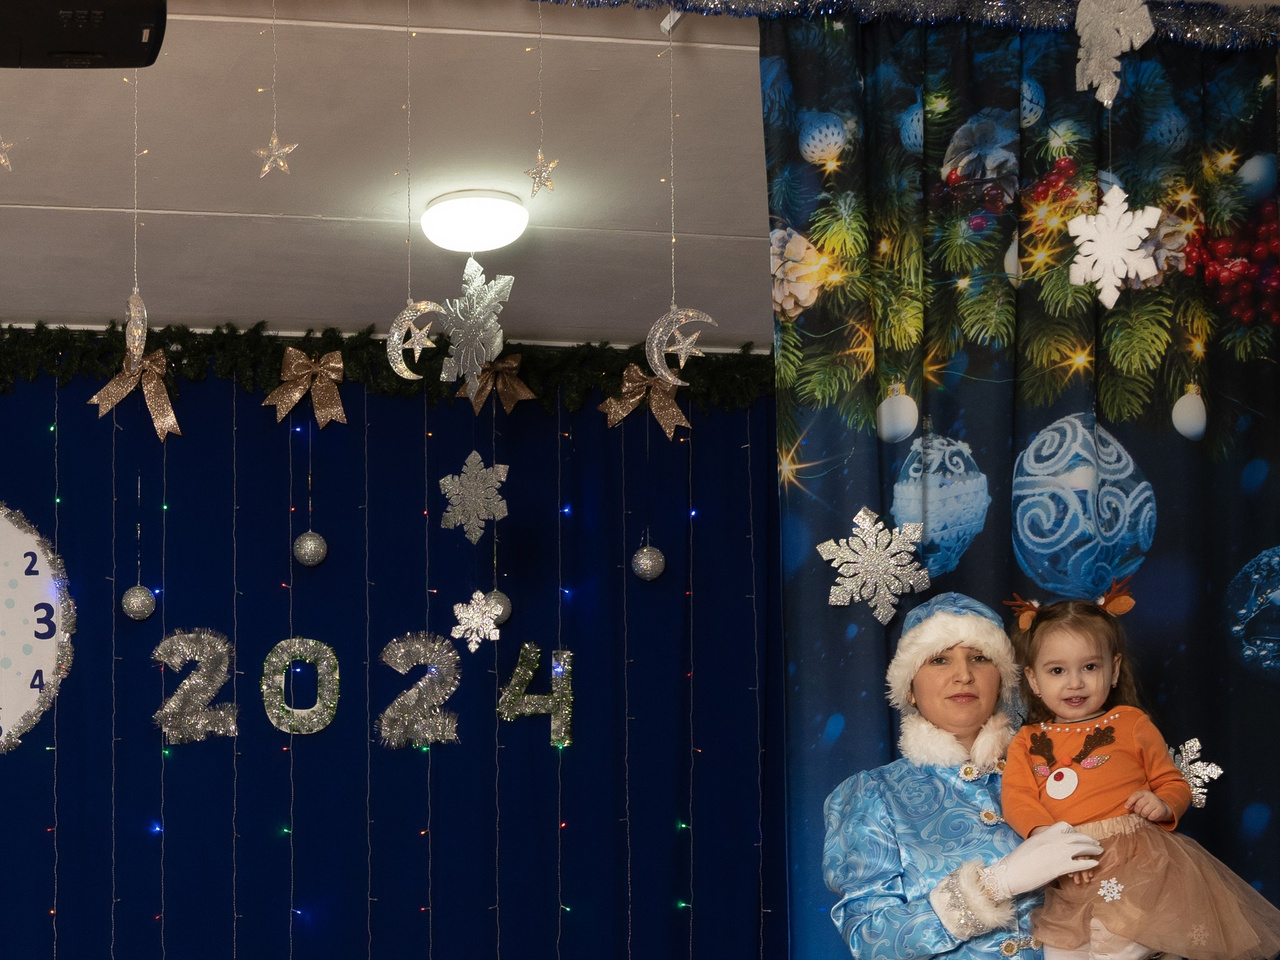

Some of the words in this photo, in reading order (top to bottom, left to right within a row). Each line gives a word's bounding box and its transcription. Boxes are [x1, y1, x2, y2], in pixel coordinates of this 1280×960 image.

[23, 552, 39, 575] 2
[33, 603, 56, 640] 3
[30, 669, 45, 693] 4
[152, 627, 575, 748] 2024
